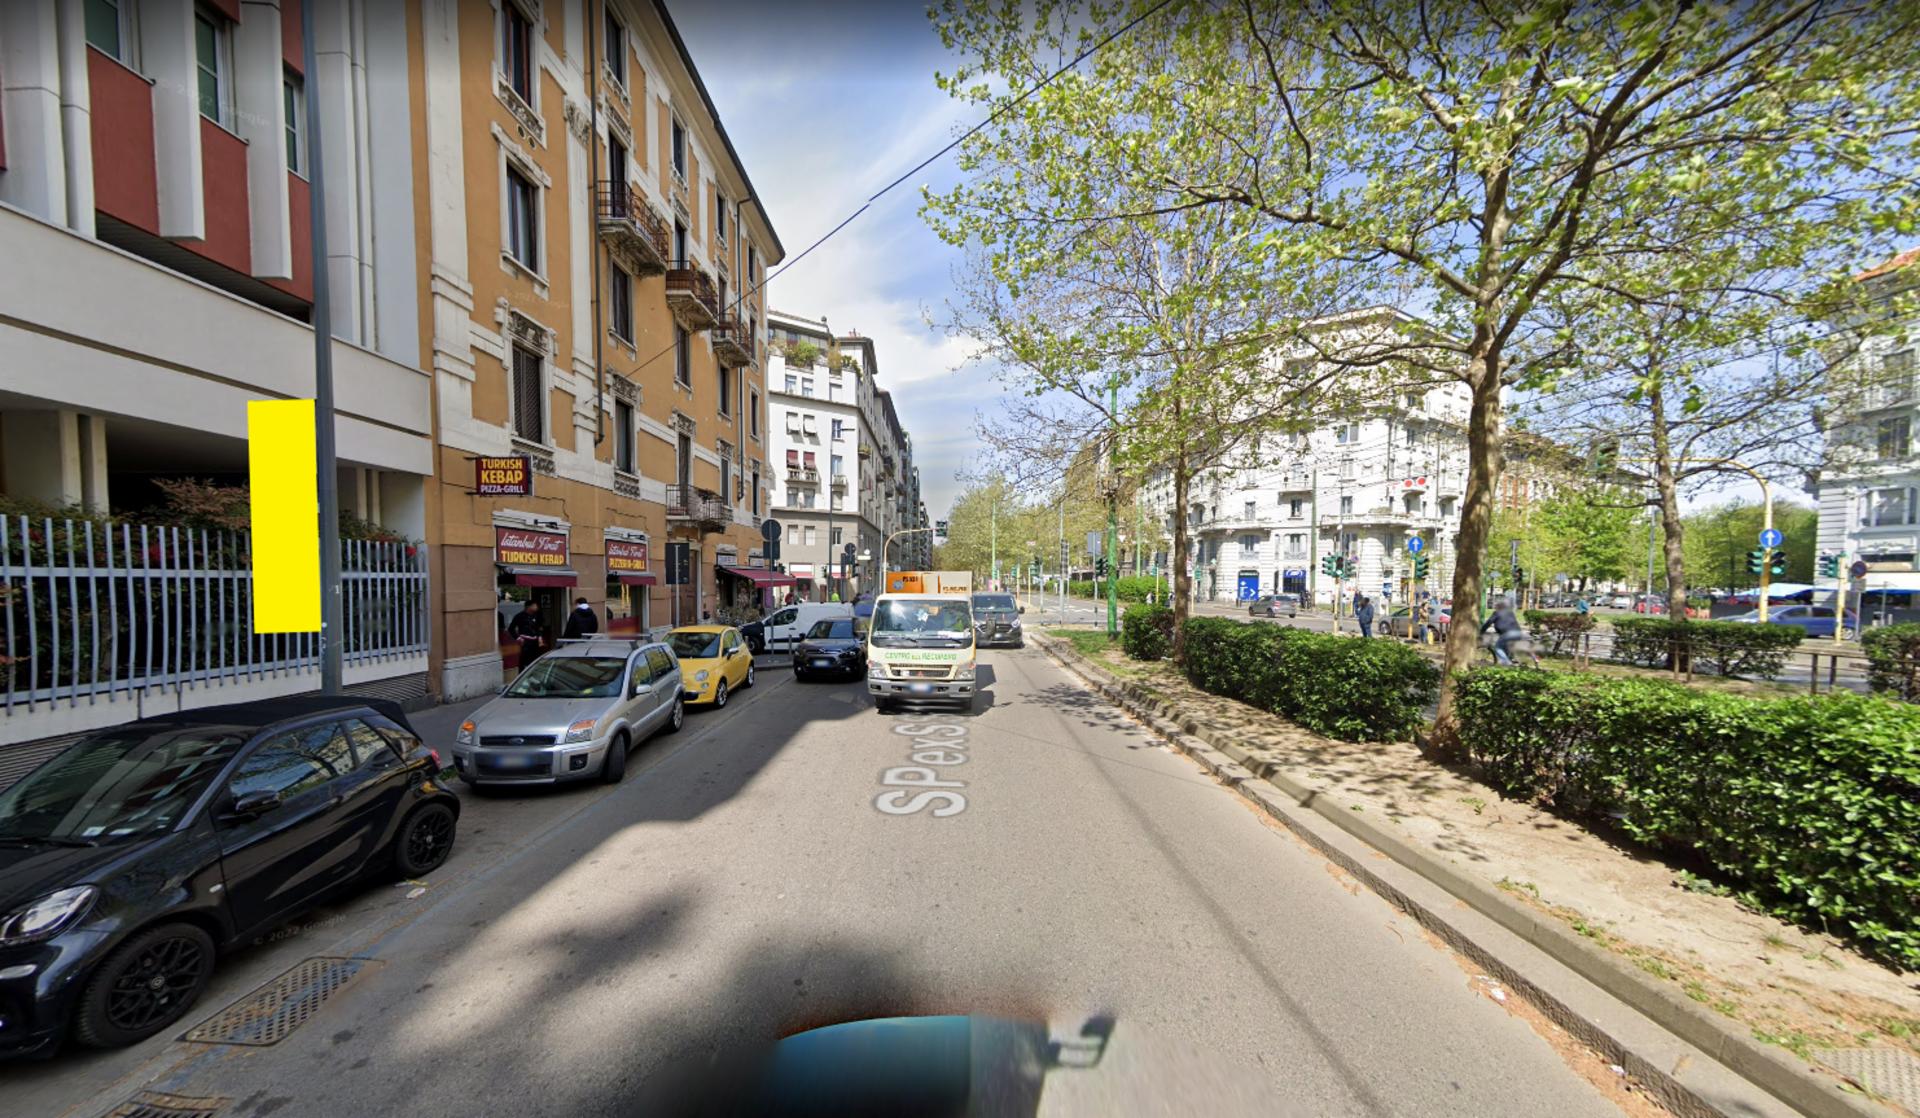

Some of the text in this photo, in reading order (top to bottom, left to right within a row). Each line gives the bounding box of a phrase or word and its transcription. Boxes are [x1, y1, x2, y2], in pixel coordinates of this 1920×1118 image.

[481, 458, 523, 470] TURKISH
[481, 470, 523, 484] KEBAP
[480, 484, 525, 493] PIZZA-GRILL
[501, 532, 538, 549] Istanbul
[501, 550, 565, 565] TURKISH KEBAP
